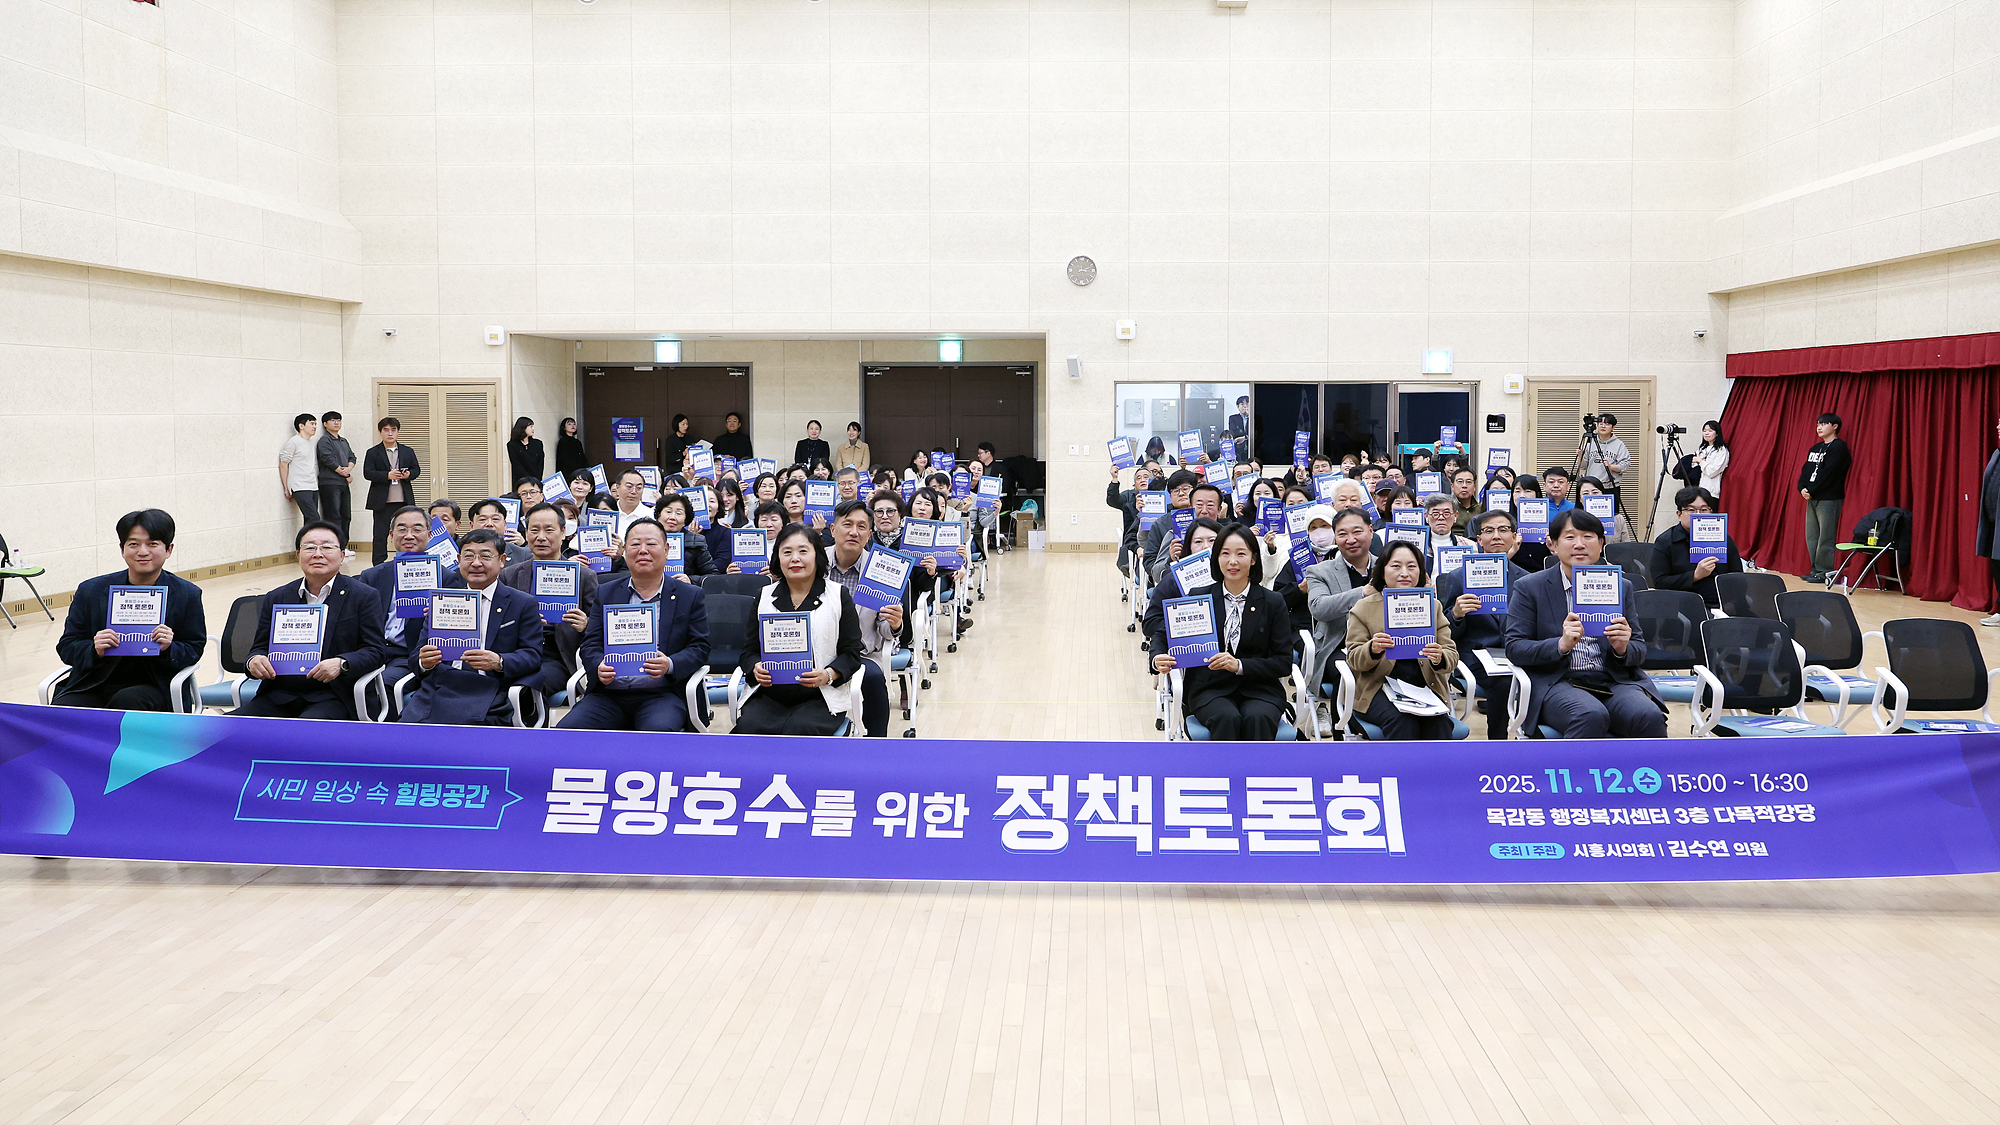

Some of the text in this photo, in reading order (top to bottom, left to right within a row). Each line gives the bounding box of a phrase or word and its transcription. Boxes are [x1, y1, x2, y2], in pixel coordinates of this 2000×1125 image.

[874, 562, 901, 575] 정책 토론회
[256, 778, 489, 809] 시민 일상 속 힐링공간
[1479, 775, 1541, 793] 2025.
[1544, 768, 1583, 794] 11.
[1666, 773, 1727, 793] 15:00
[1749, 773, 1809, 793] 16:30
[543, 767, 1405, 857] 물왕호수를 위한 정책토론회
[1486, 803, 1817, 827] 목감동 행정복지센터 3층 다목적강당
[1498, 839, 1770, 859] 주최 주관 시흥시의회 김수연 의원
